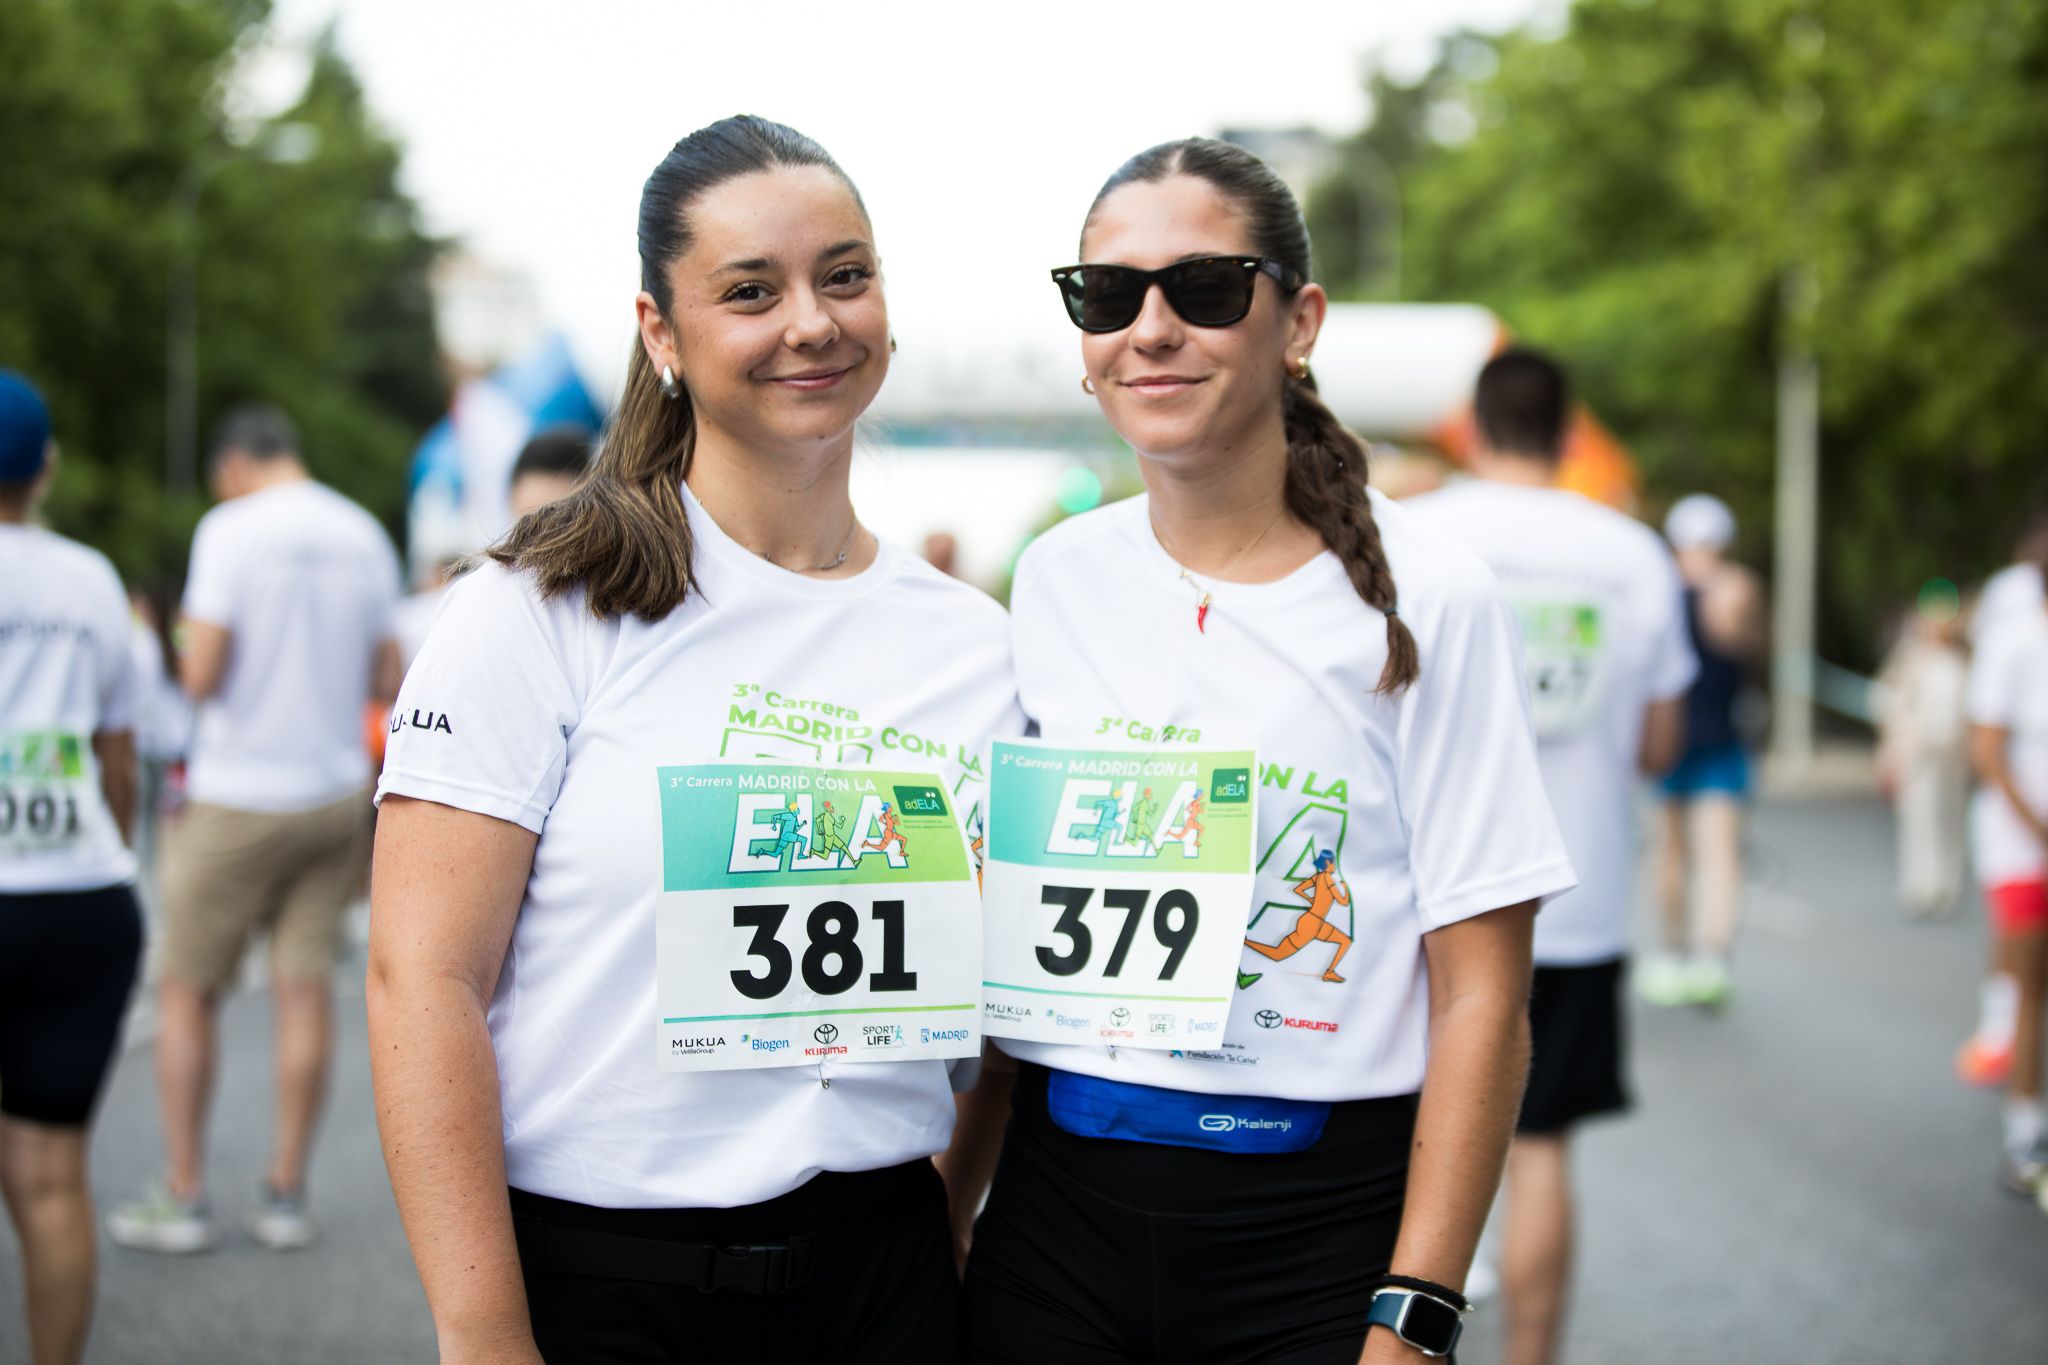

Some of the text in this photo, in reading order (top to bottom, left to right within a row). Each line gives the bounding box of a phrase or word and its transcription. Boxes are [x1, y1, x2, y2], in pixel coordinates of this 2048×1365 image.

[765, 691, 860, 722] Carrera
[728, 704, 873, 743] MADRID
[881, 727, 947, 759] CON
[958, 744, 984, 776] LA
[1015, 755, 1064, 771] Carrera
[1068, 759, 1142, 776] MADRID
[1142, 761, 1177, 777] CON
[1178, 761, 1199, 777] LA
[686, 776, 733, 788] Carrera
[738, 775, 811, 790] MADRID
[815, 776, 850, 791] CON
[855, 778, 876, 792] LA
[1301, 770, 1348, 804] LA
[904, 798, 941, 811] adELA
[1044, 777, 1200, 859] ELA
[726, 792, 909, 875] ELA
[1035, 884, 1200, 981] 379
[730, 899, 918, 1000] 381
[985, 1003, 1032, 1017] MUKUA
[1056, 1015, 1090, 1030] Biogen
[1150, 1023, 1168, 1033] LIFE
[862, 1025, 895, 1036] SPORT
[932, 1029, 969, 1042] MADRID
[672, 1037, 726, 1049] MUKUA
[752, 1038, 790, 1052] Biogen
[867, 1035, 891, 1046] LIFE
[1237, 1118, 1292, 1133] Kalenji
